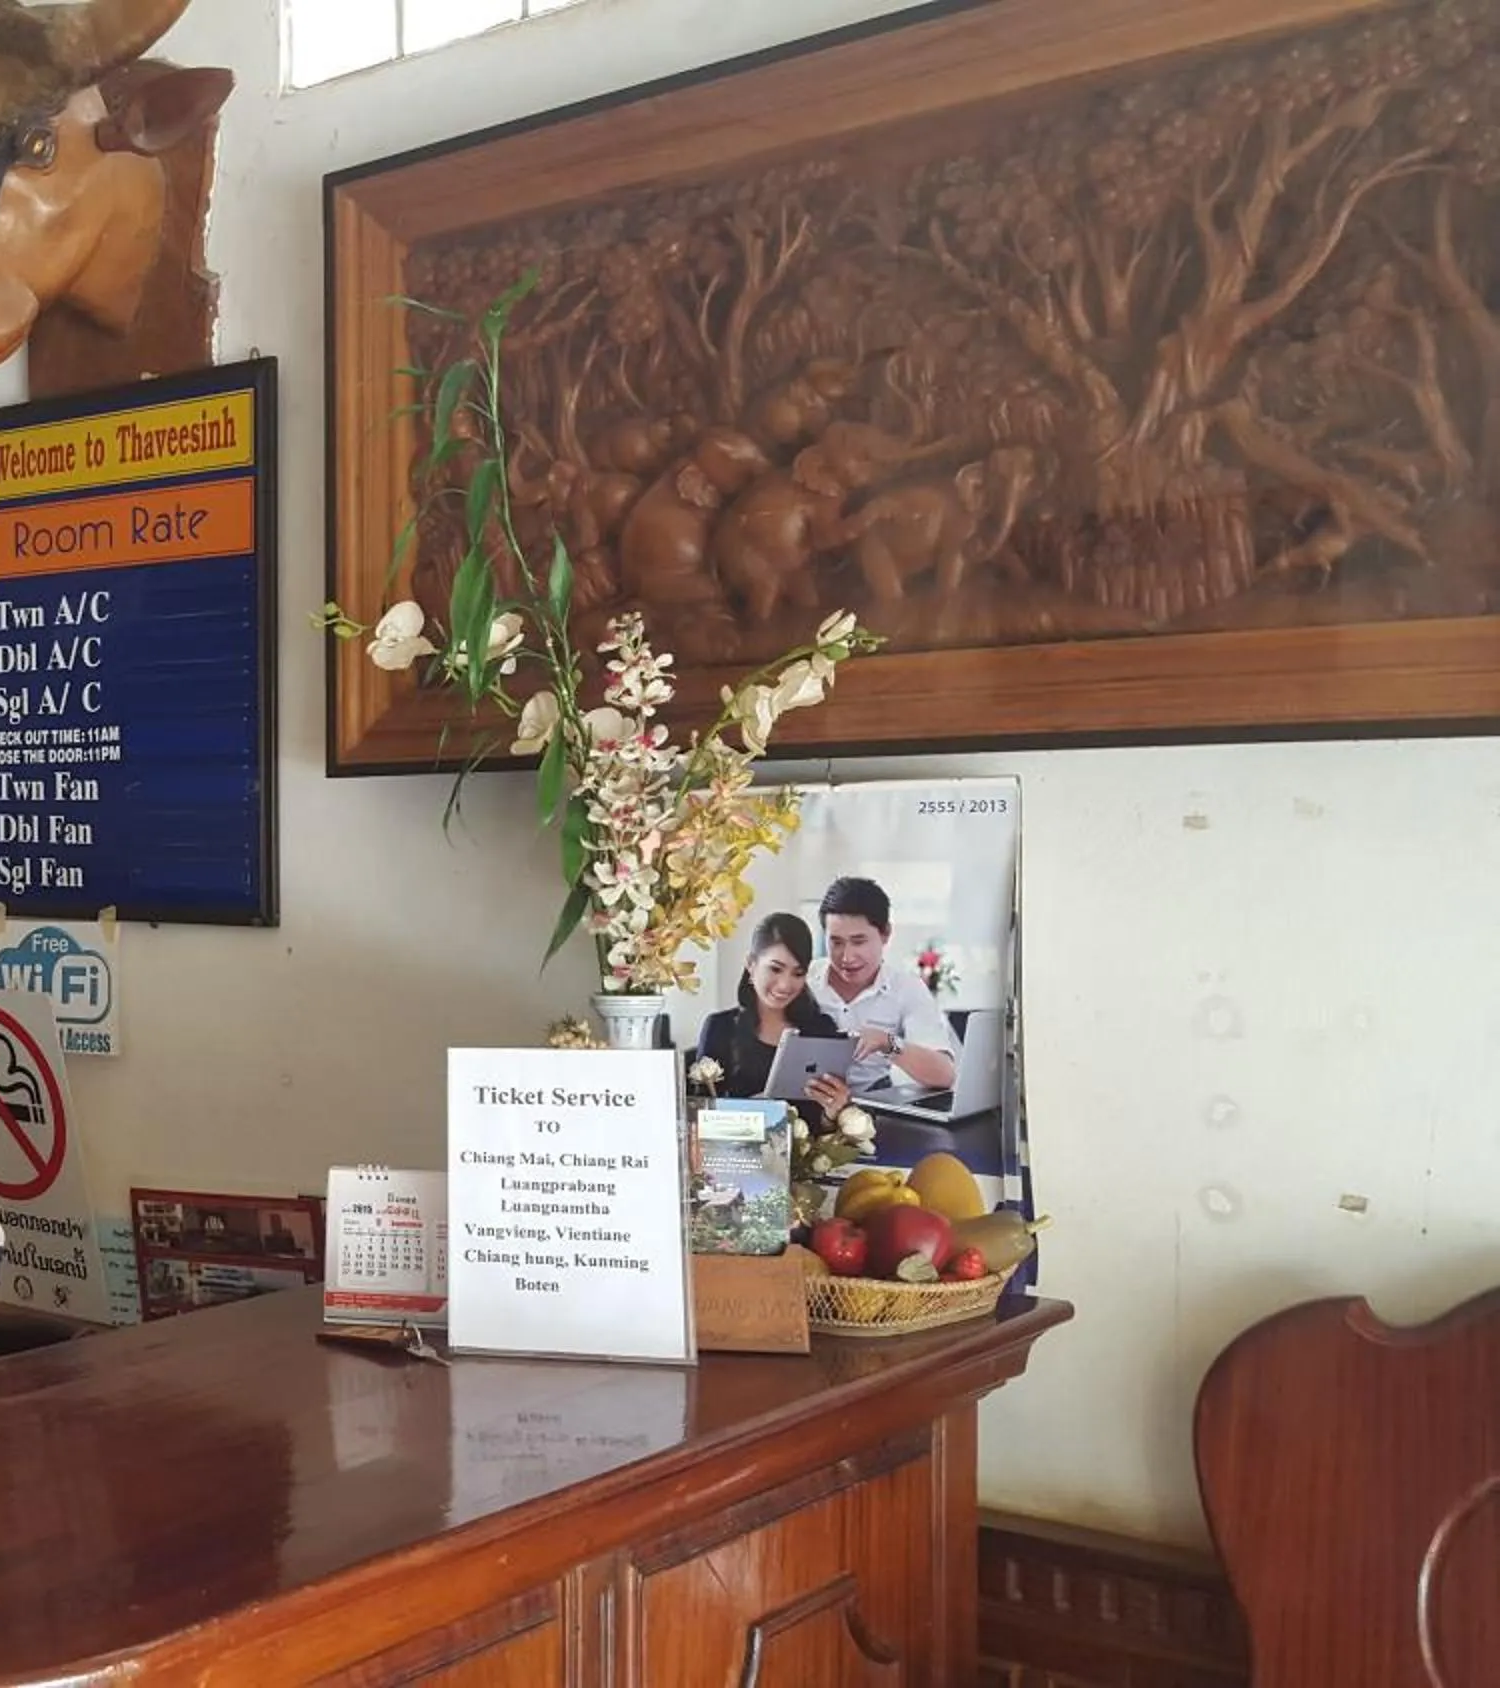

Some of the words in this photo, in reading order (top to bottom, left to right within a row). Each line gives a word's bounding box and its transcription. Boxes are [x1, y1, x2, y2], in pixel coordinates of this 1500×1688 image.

[85, 431, 105, 468] to
[116, 405, 237, 464] Thaveesinh
[13, 520, 113, 559] Room
[131, 503, 210, 545] Rate
[54, 591, 110, 626] A/C
[46, 635, 102, 671] A/C
[25, 729, 49, 745] OUT
[22, 748, 46, 763] THE
[54, 771, 99, 801] Fan
[918, 800, 955, 814] 2555
[970, 799, 1007, 813] 2013
[49, 814, 93, 845] Fan
[39, 857, 84, 888] Fan
[32, 933, 69, 953] Free
[473, 1085, 544, 1106] Ticket
[551, 1087, 636, 1108] Service
[533, 1120, 561, 1134] TO
[460, 1151, 515, 1168] Chiang
[520, 1152, 555, 1168] Mai,
[559, 1153, 617, 1170] Chiang
[621, 1155, 649, 1169] Rai
[501, 1177, 616, 1196] Luangprabang
[501, 1199, 610, 1216] Luangnamtha
[465, 1223, 550, 1242] Vangvieng,
[556, 1226, 631, 1242] Vientiane
[464, 1249, 520, 1267] Chiang
[525, 1251, 569, 1268] hung,
[574, 1253, 650, 1272] Kunming
[515, 1277, 560, 1293] Boten
